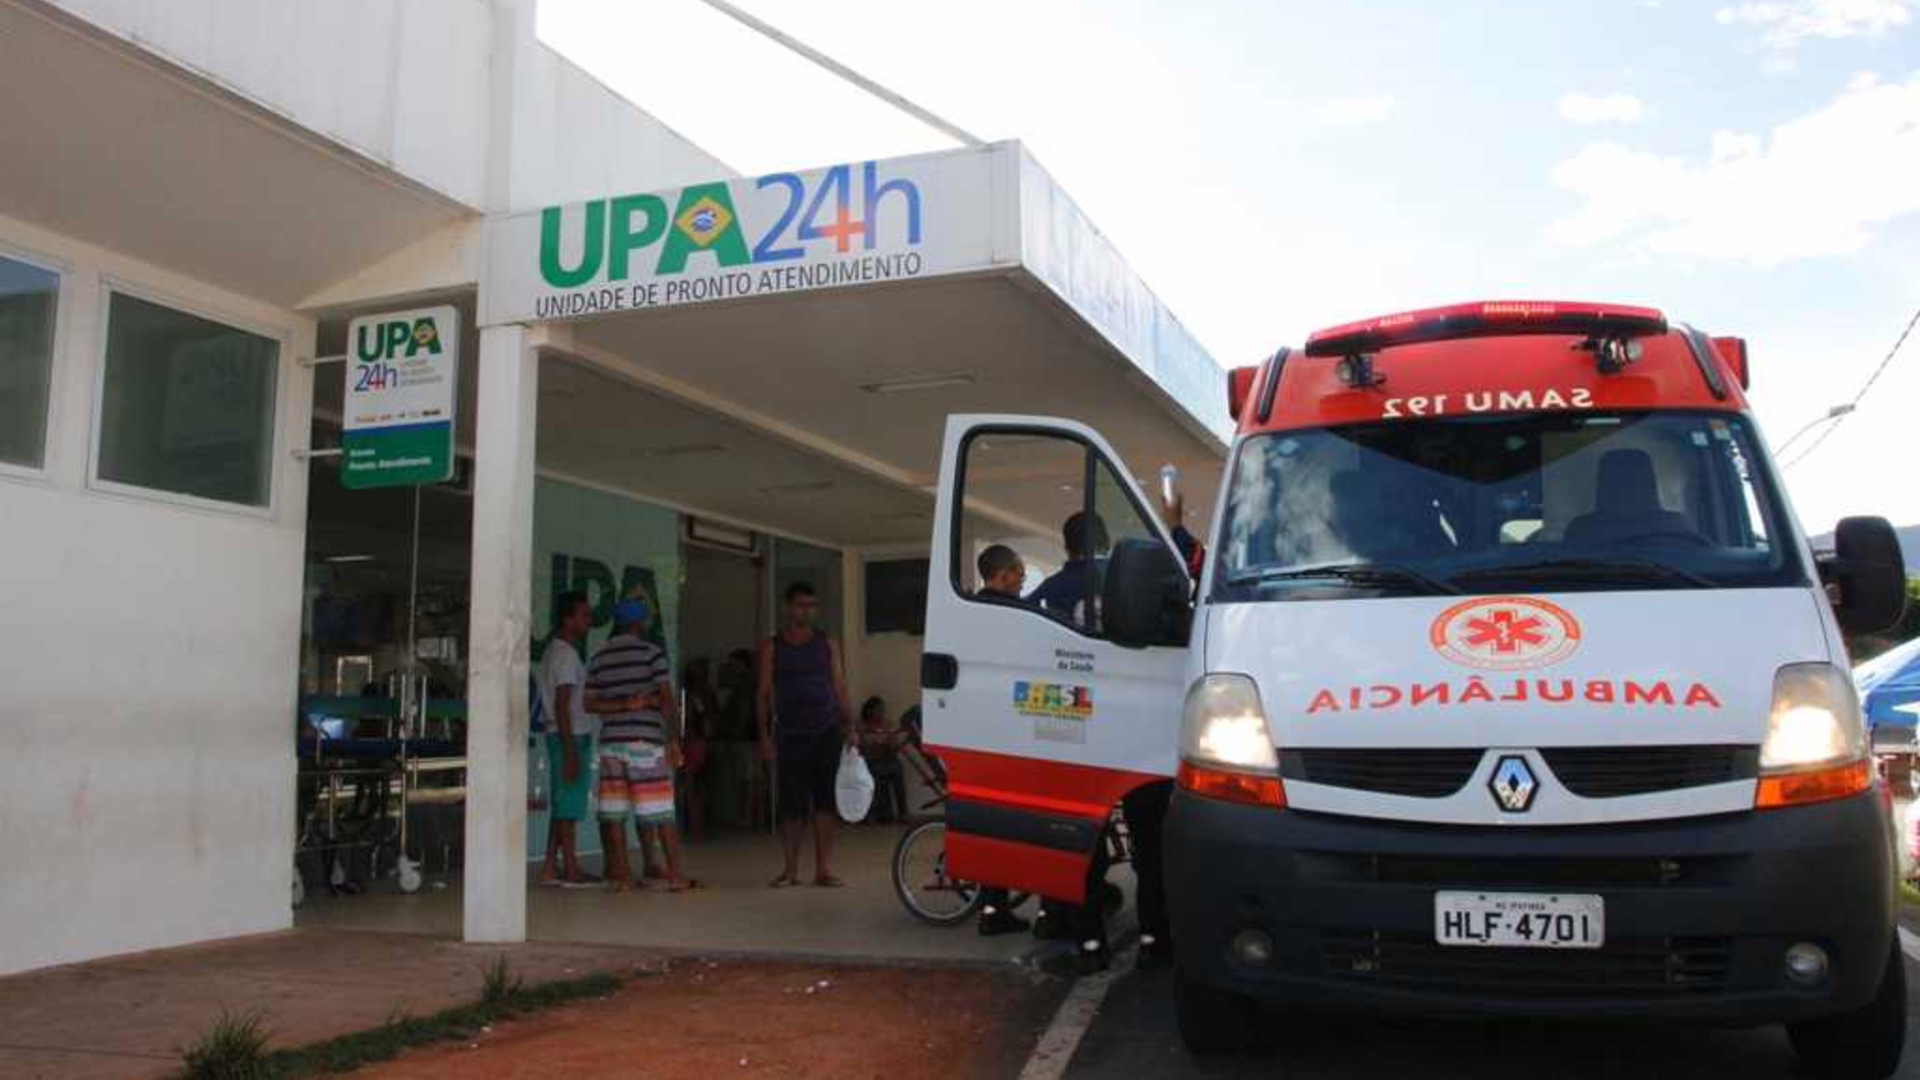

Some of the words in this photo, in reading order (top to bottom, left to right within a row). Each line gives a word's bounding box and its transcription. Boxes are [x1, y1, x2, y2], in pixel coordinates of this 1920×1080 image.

[539, 181, 751, 289] UPA
[750, 160, 921, 264] 24h
[535, 289, 625, 319] UNIDADE
[632, 284, 659, 307] DE
[666, 273, 751, 302] PRONTO
[758, 251, 921, 291] ATENDIMENTO
[357, 316, 442, 363] UPA
[354, 362, 397, 392] 24h
[1013, 681, 1094, 708] BRASIL
